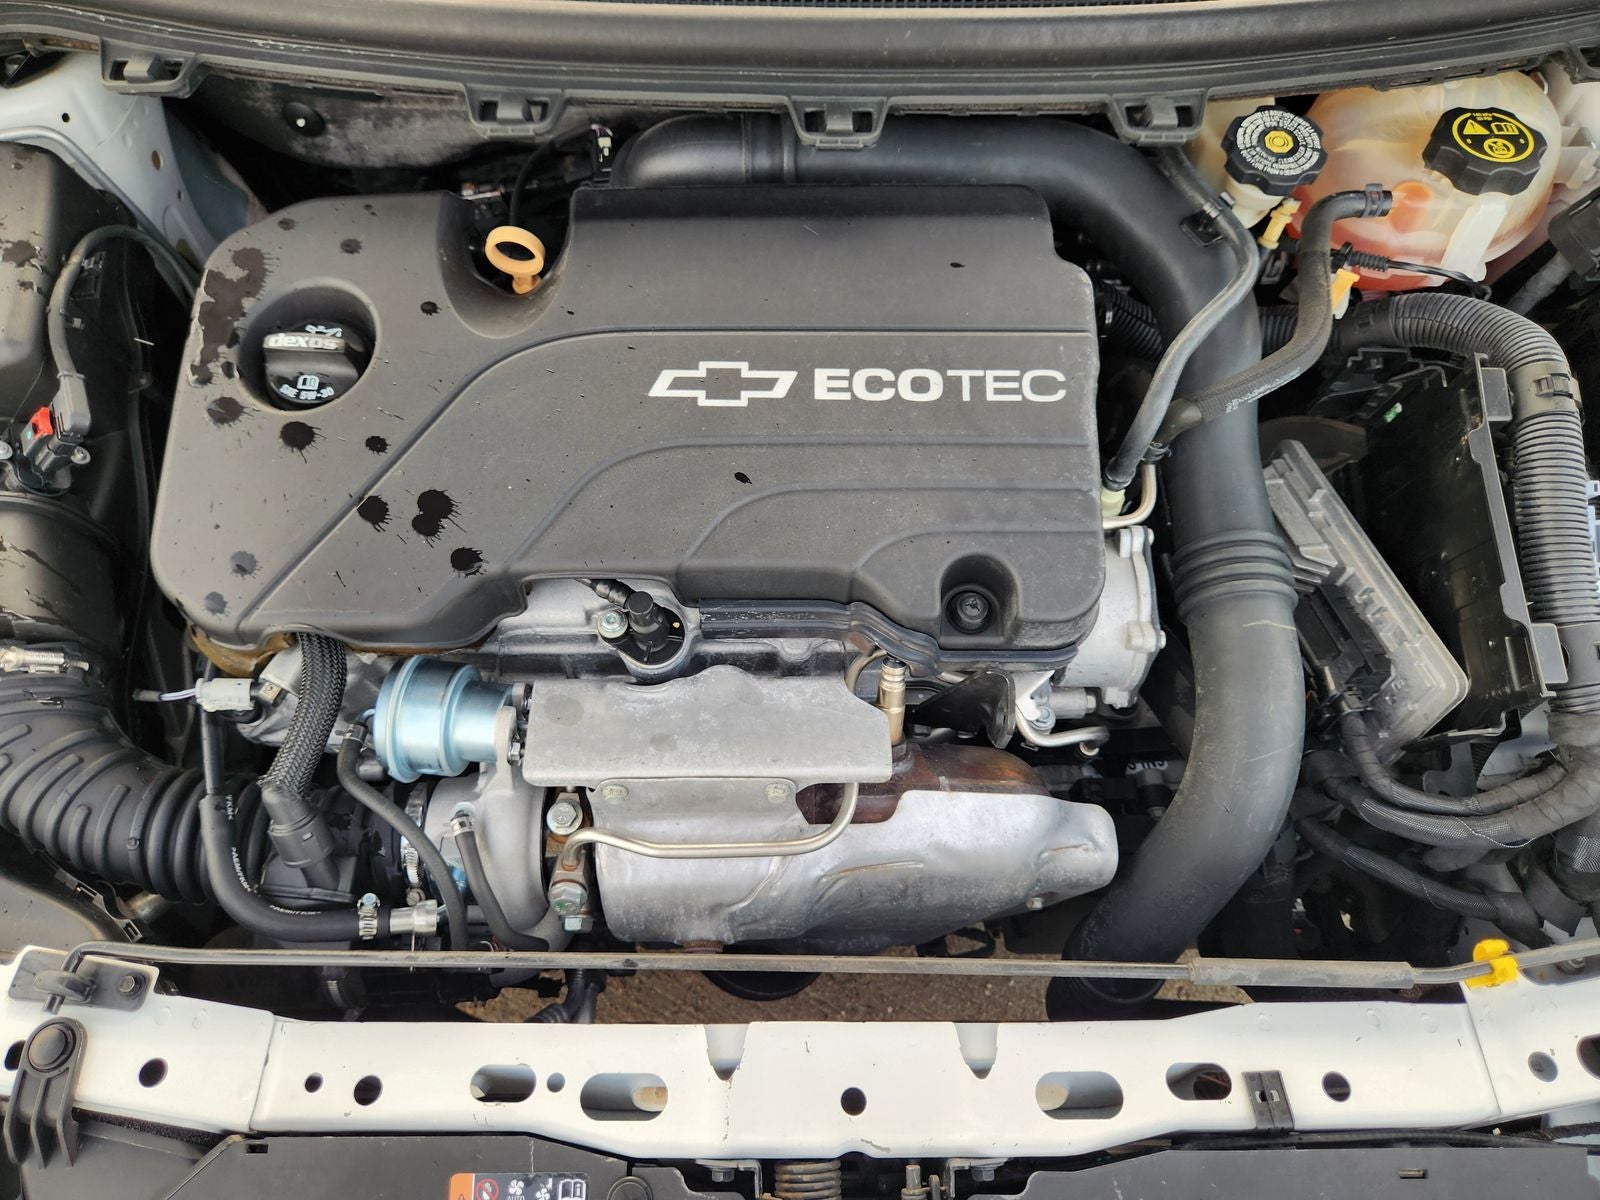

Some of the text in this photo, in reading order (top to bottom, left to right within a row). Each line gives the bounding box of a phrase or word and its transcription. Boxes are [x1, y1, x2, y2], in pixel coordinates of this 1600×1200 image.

[269, 333, 337, 350] dexos
[299, 386, 335, 400] 5W-30
[813, 367, 1067, 402] ECOTEC
